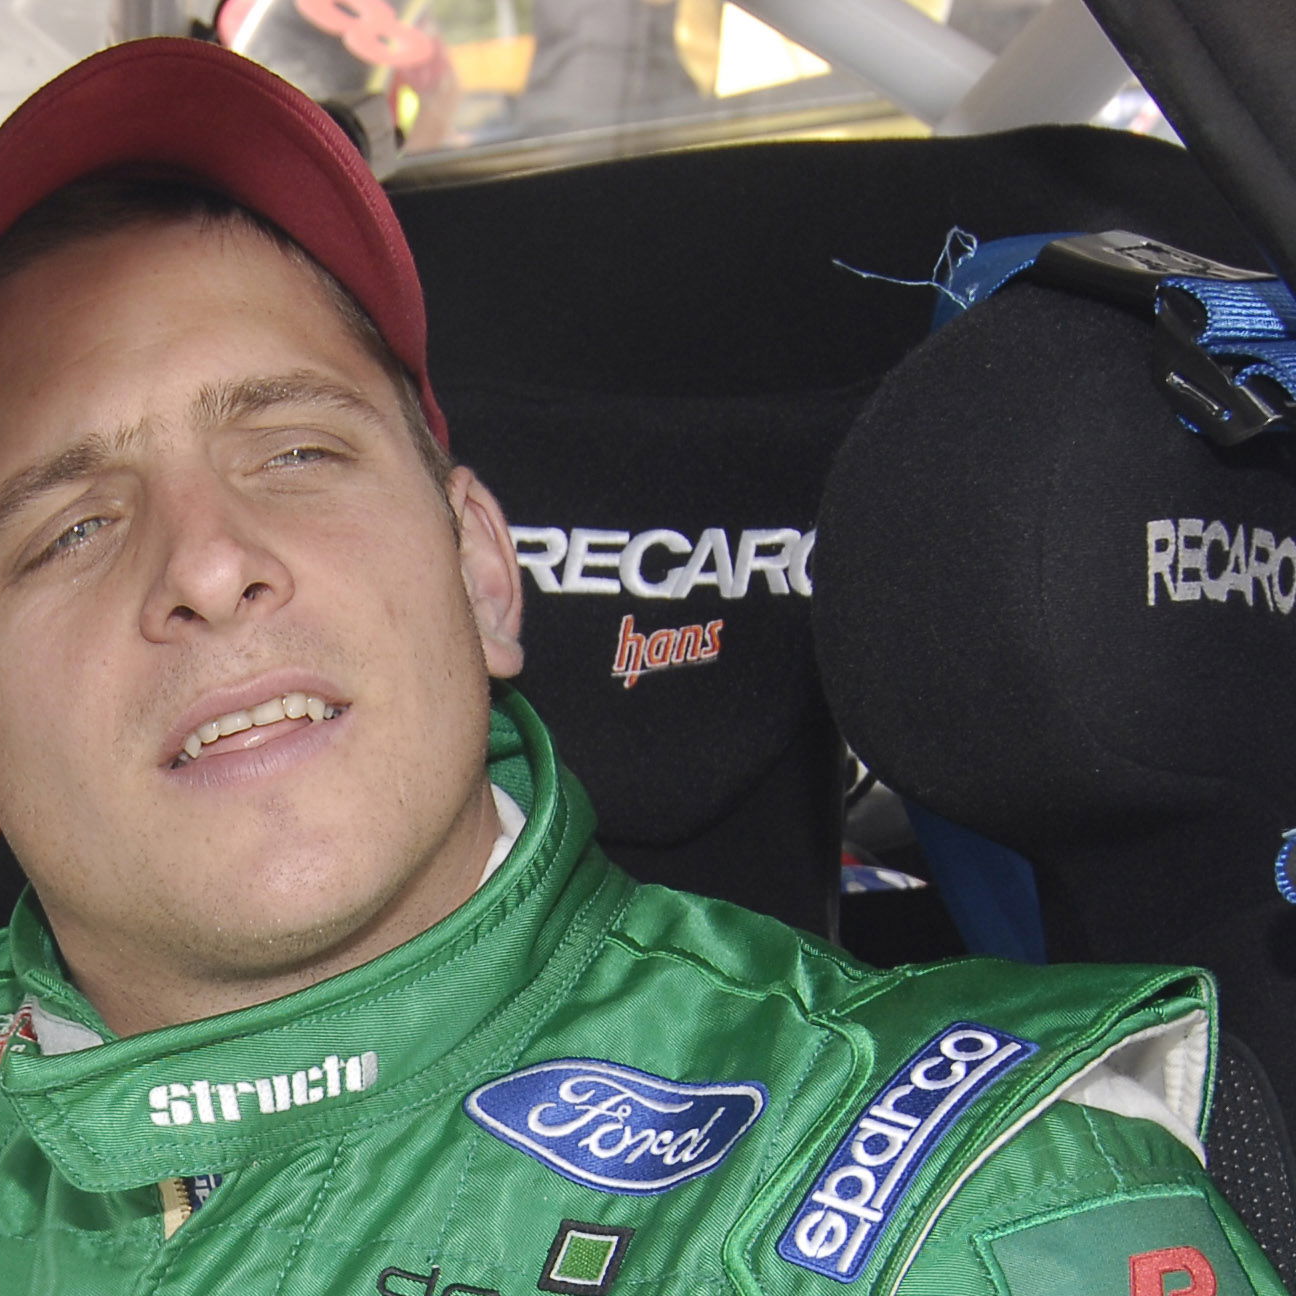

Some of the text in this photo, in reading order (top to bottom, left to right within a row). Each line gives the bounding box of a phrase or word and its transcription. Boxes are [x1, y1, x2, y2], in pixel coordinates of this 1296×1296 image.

[1147, 518, 1296, 615] RECARO
[611, 614, 724, 690] hans
[527, 1075, 726, 1166] Ford
[794, 1029, 1004, 1265] sparco
